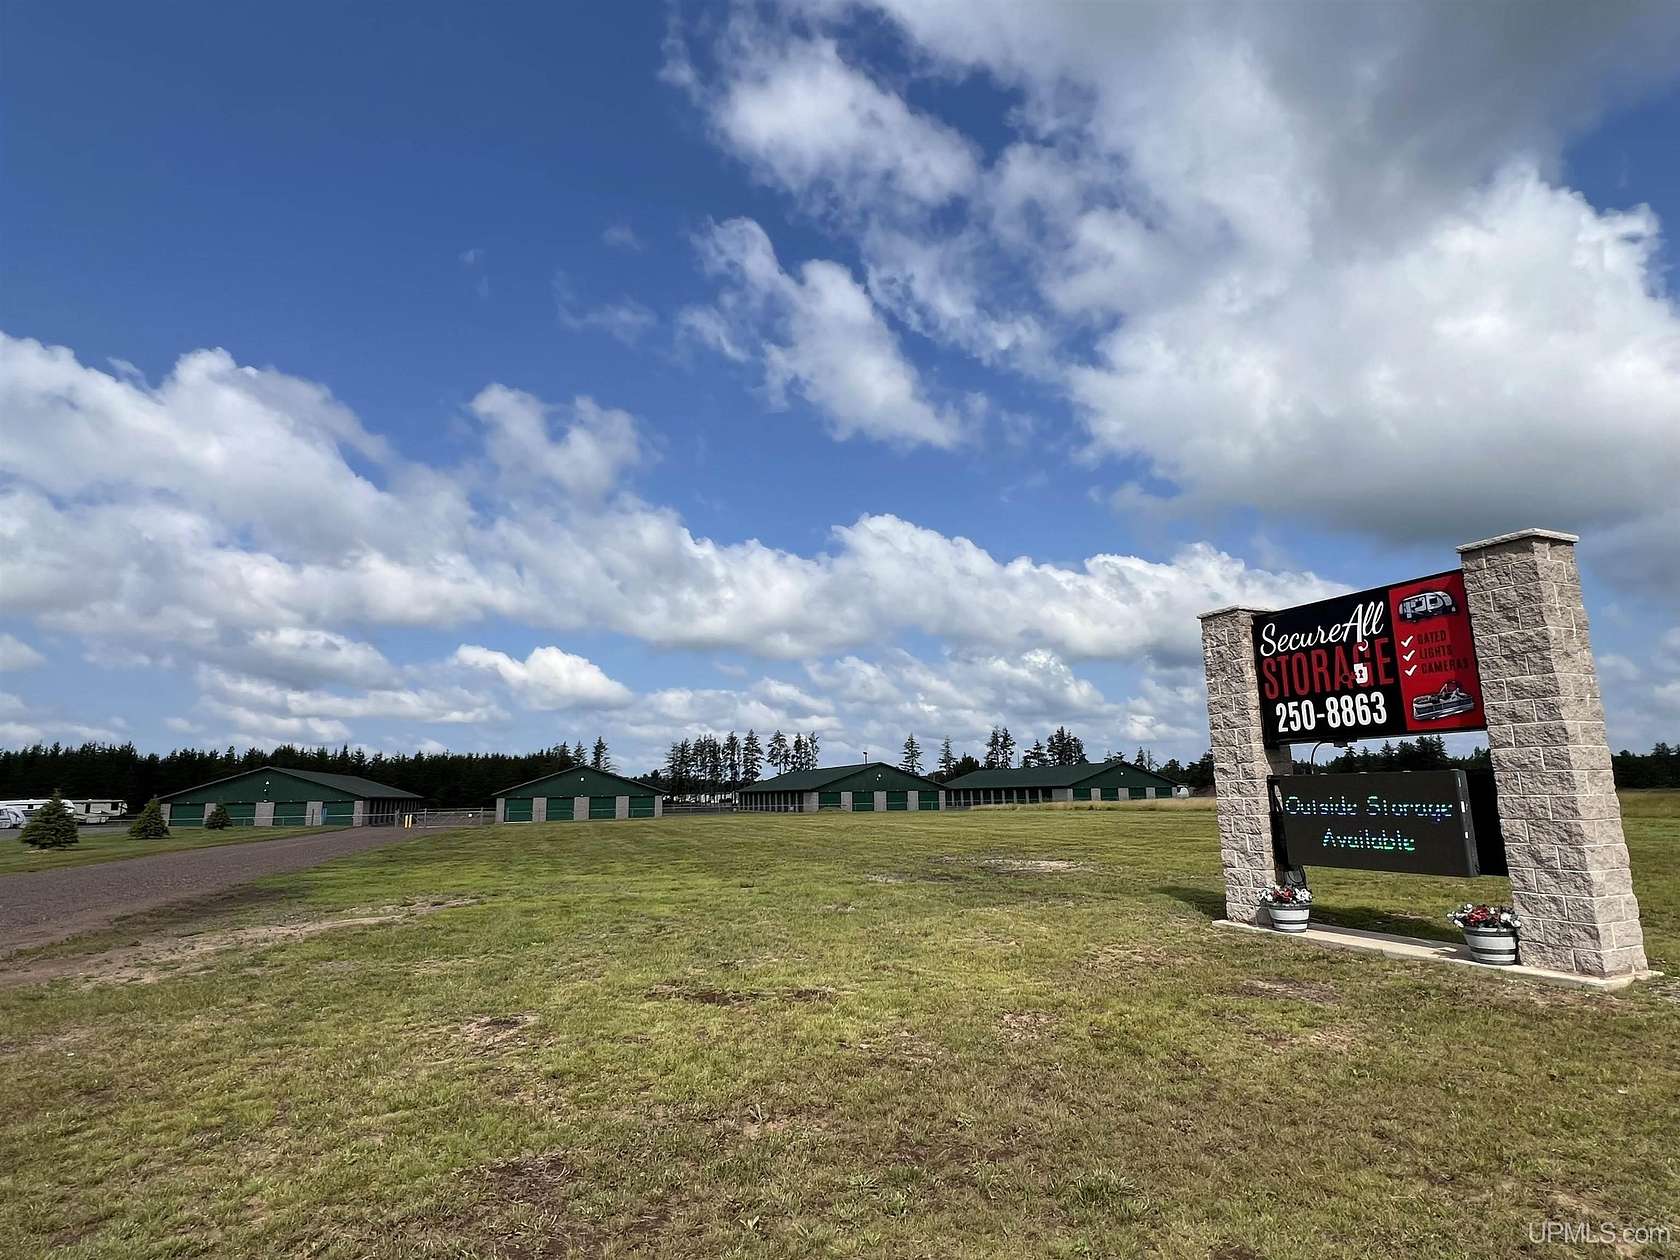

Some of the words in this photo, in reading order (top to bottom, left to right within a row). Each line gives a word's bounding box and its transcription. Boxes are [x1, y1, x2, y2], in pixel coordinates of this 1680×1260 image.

[1260, 601, 1384, 656] SecureAll
[1417, 630, 1446, 644] GATED
[1420, 645, 1453, 659] LIGHTS
[1262, 637, 1394, 699] STORAGE
[1421, 658, 1469, 674] CAMERAS
[1276, 691, 1387, 733] 250-8863
[1285, 796, 1357, 815] Outside
[1367, 796, 1452, 822] Storage
[1323, 828, 1415, 850] Available
